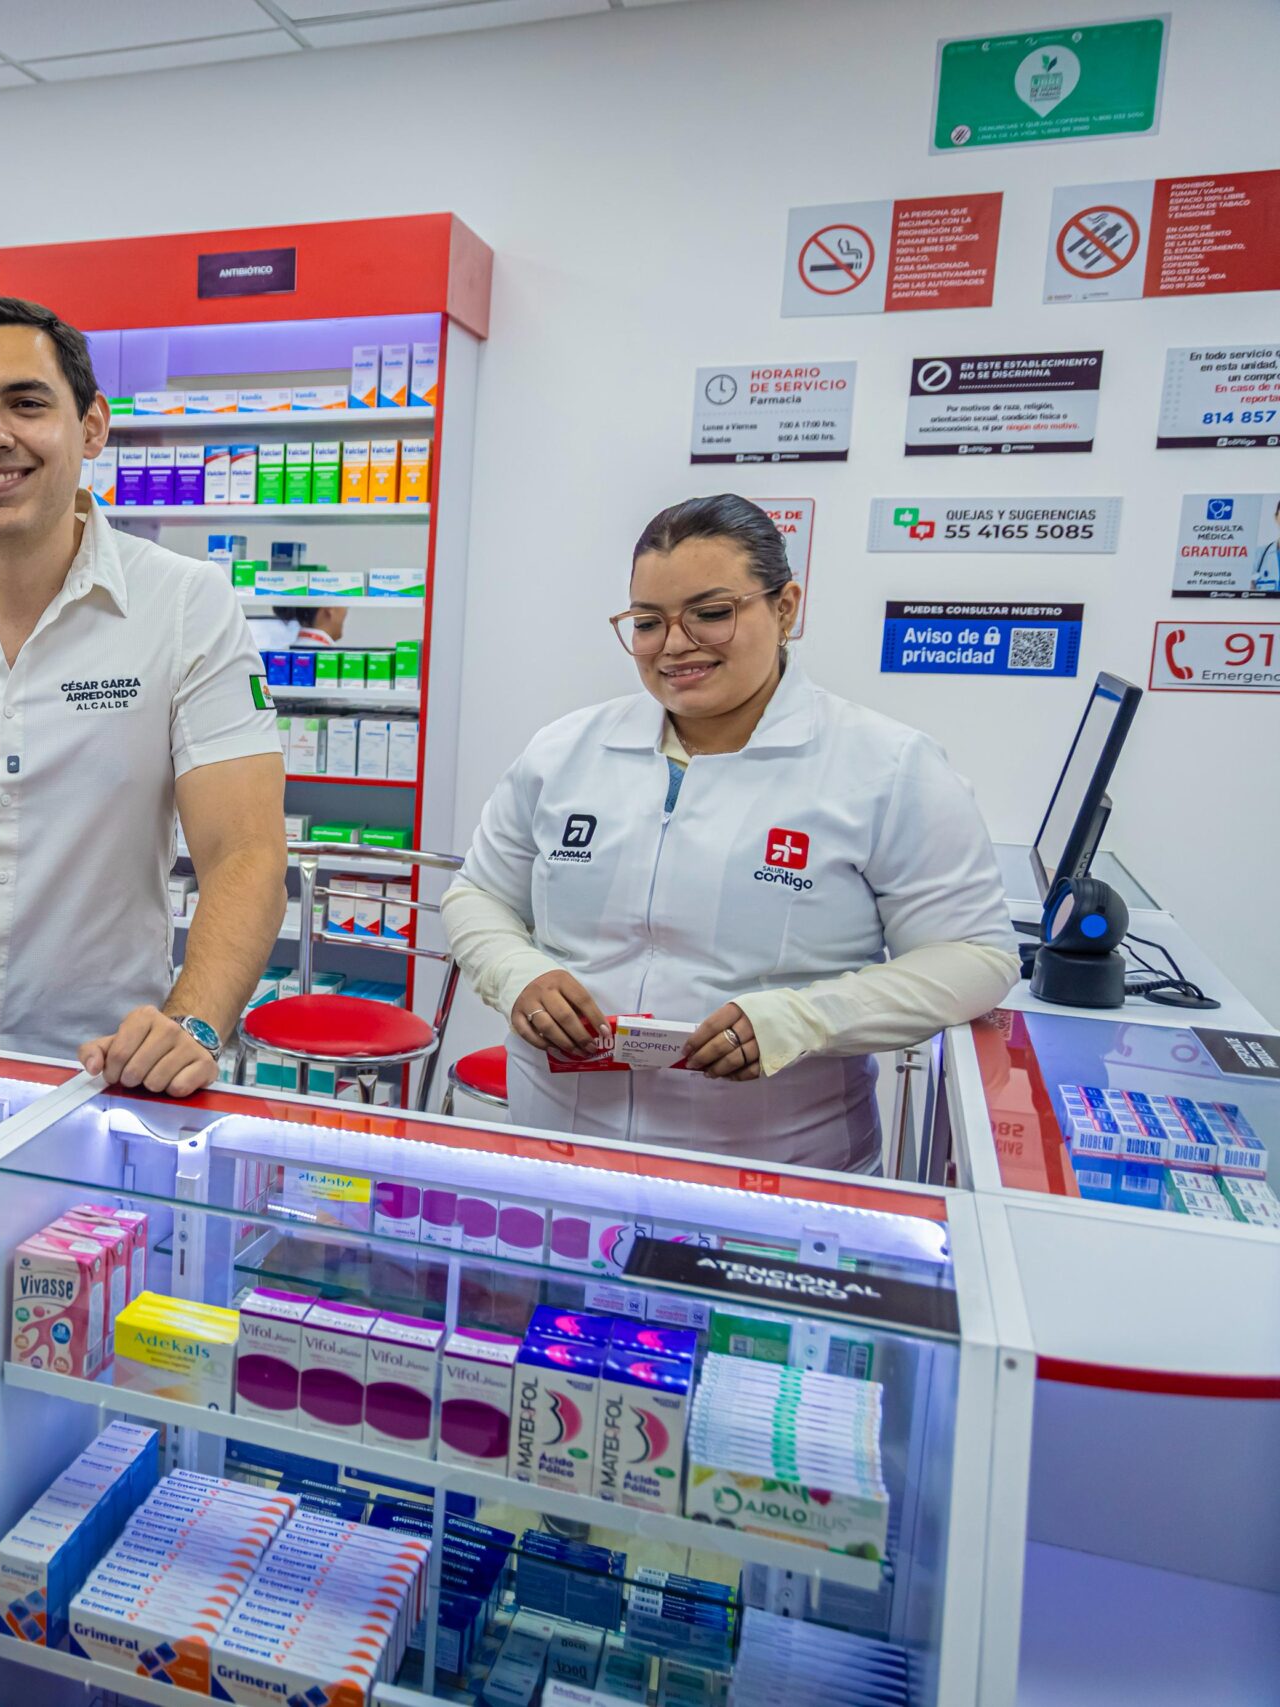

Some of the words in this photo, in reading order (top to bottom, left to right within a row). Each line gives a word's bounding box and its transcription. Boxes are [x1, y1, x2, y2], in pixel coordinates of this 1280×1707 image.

[1171, 181, 1215, 189] PROHIBIDO
[1169, 196, 1202, 204] ESPACIO
[1203, 194, 1221, 202] 100%
[1223, 192, 1245, 200] LIBRE
[1170, 189, 1197, 197] FUMAR
[1203, 187, 1234, 195] VAPEAR
[1219, 199, 1250, 208] TABACO
[911, 209, 949, 217] PERSONA
[951, 207, 968, 215] QUE
[1168, 211, 1173, 219] Y
[1175, 209, 1215, 218] EMISIONES
[898, 218, 940, 228] INCUMPLA
[942, 217, 959, 225] CON
[961, 216, 971, 224] LA
[898, 226, 950, 237] PROHIBICIÓN
[897, 237, 925, 245] FUMAR
[940, 234, 979, 243] ESPACIOS
[917, 245, 944, 253] LIBRES
[946, 244, 956, 252] DE
[219, 264, 273, 278] ANTIBIÓTICO
[895, 263, 915, 272] SERÁ
[916, 261, 969, 271] SANCIONADA
[894, 269, 987, 281] ADMINISTRATIVAMENTE
[893, 281, 909, 289] POR
[911, 280, 926, 288] LAS
[928, 278, 985, 288] AUTORIDADES
[1190, 352, 1201, 361] En
[1206, 351, 1226, 360] todo
[1230, 349, 1272, 359] servicio
[961, 363, 974, 371] EN
[977, 362, 1000, 370] ESTE
[1003, 357, 1097, 369] ESTABLECIMIENTO
[1200, 364, 1212, 372] en
[1216, 362, 1237, 370] esta
[1241, 361, 1278, 370] unidad,
[751, 368, 821, 380] HORARIO
[960, 372, 974, 380] NO
[977, 371, 989, 379] SE
[992, 369, 1051, 378] DISCRIMINA
[750, 382, 769, 393] DE
[775, 380, 847, 392] SERVICIO
[1215, 384, 1227, 393] En
[1258, 383, 1270, 391] de
[750, 395, 802, 405] Farmacia
[1203, 412, 1234, 424] 814
[1241, 410, 1277, 423] 857
[785, 511, 803, 520] DE
[946, 509, 993, 522] QUEJAS
[998, 510, 1005, 520] Y
[1008, 509, 1097, 521] SUGERENCIAS
[944, 524, 970, 539] 55
[977, 524, 1028, 539] 4165
[1035, 524, 1094, 539] 5085
[1181, 545, 1248, 558] GRATUITA
[903, 606, 944, 615] PUEDES
[946, 606, 1008, 615] CONSULTAR
[1011, 607, 1062, 616] NUESTRO
[903, 628, 953, 644] Aviso
[957, 628, 979, 645] de
[901, 647, 995, 665] privacidad
[61, 680, 98, 692] CÉSAR
[101, 677, 141, 689] GARZA
[66, 689, 138, 702] ARREDONDO
[76, 700, 129, 711] ALCALDE
[550, 850, 591, 859] APODACA
[754, 870, 813, 891] contigo
[20, 1274, 74, 1299] Vivasse
[844, 1283, 881, 1298] AL
[242, 1323, 272, 1340] Vifol
[134, 1331, 210, 1359] Adekals
[305, 1335, 336, 1352] Vifol
[371, 1349, 403, 1367] Vifol
[539, 1452, 573, 1467] Ácido
[538, 1463, 574, 1478] Fólico
[74, 1623, 139, 1651] Grimeral
[217, 1665, 287, 1695] Grimeral
